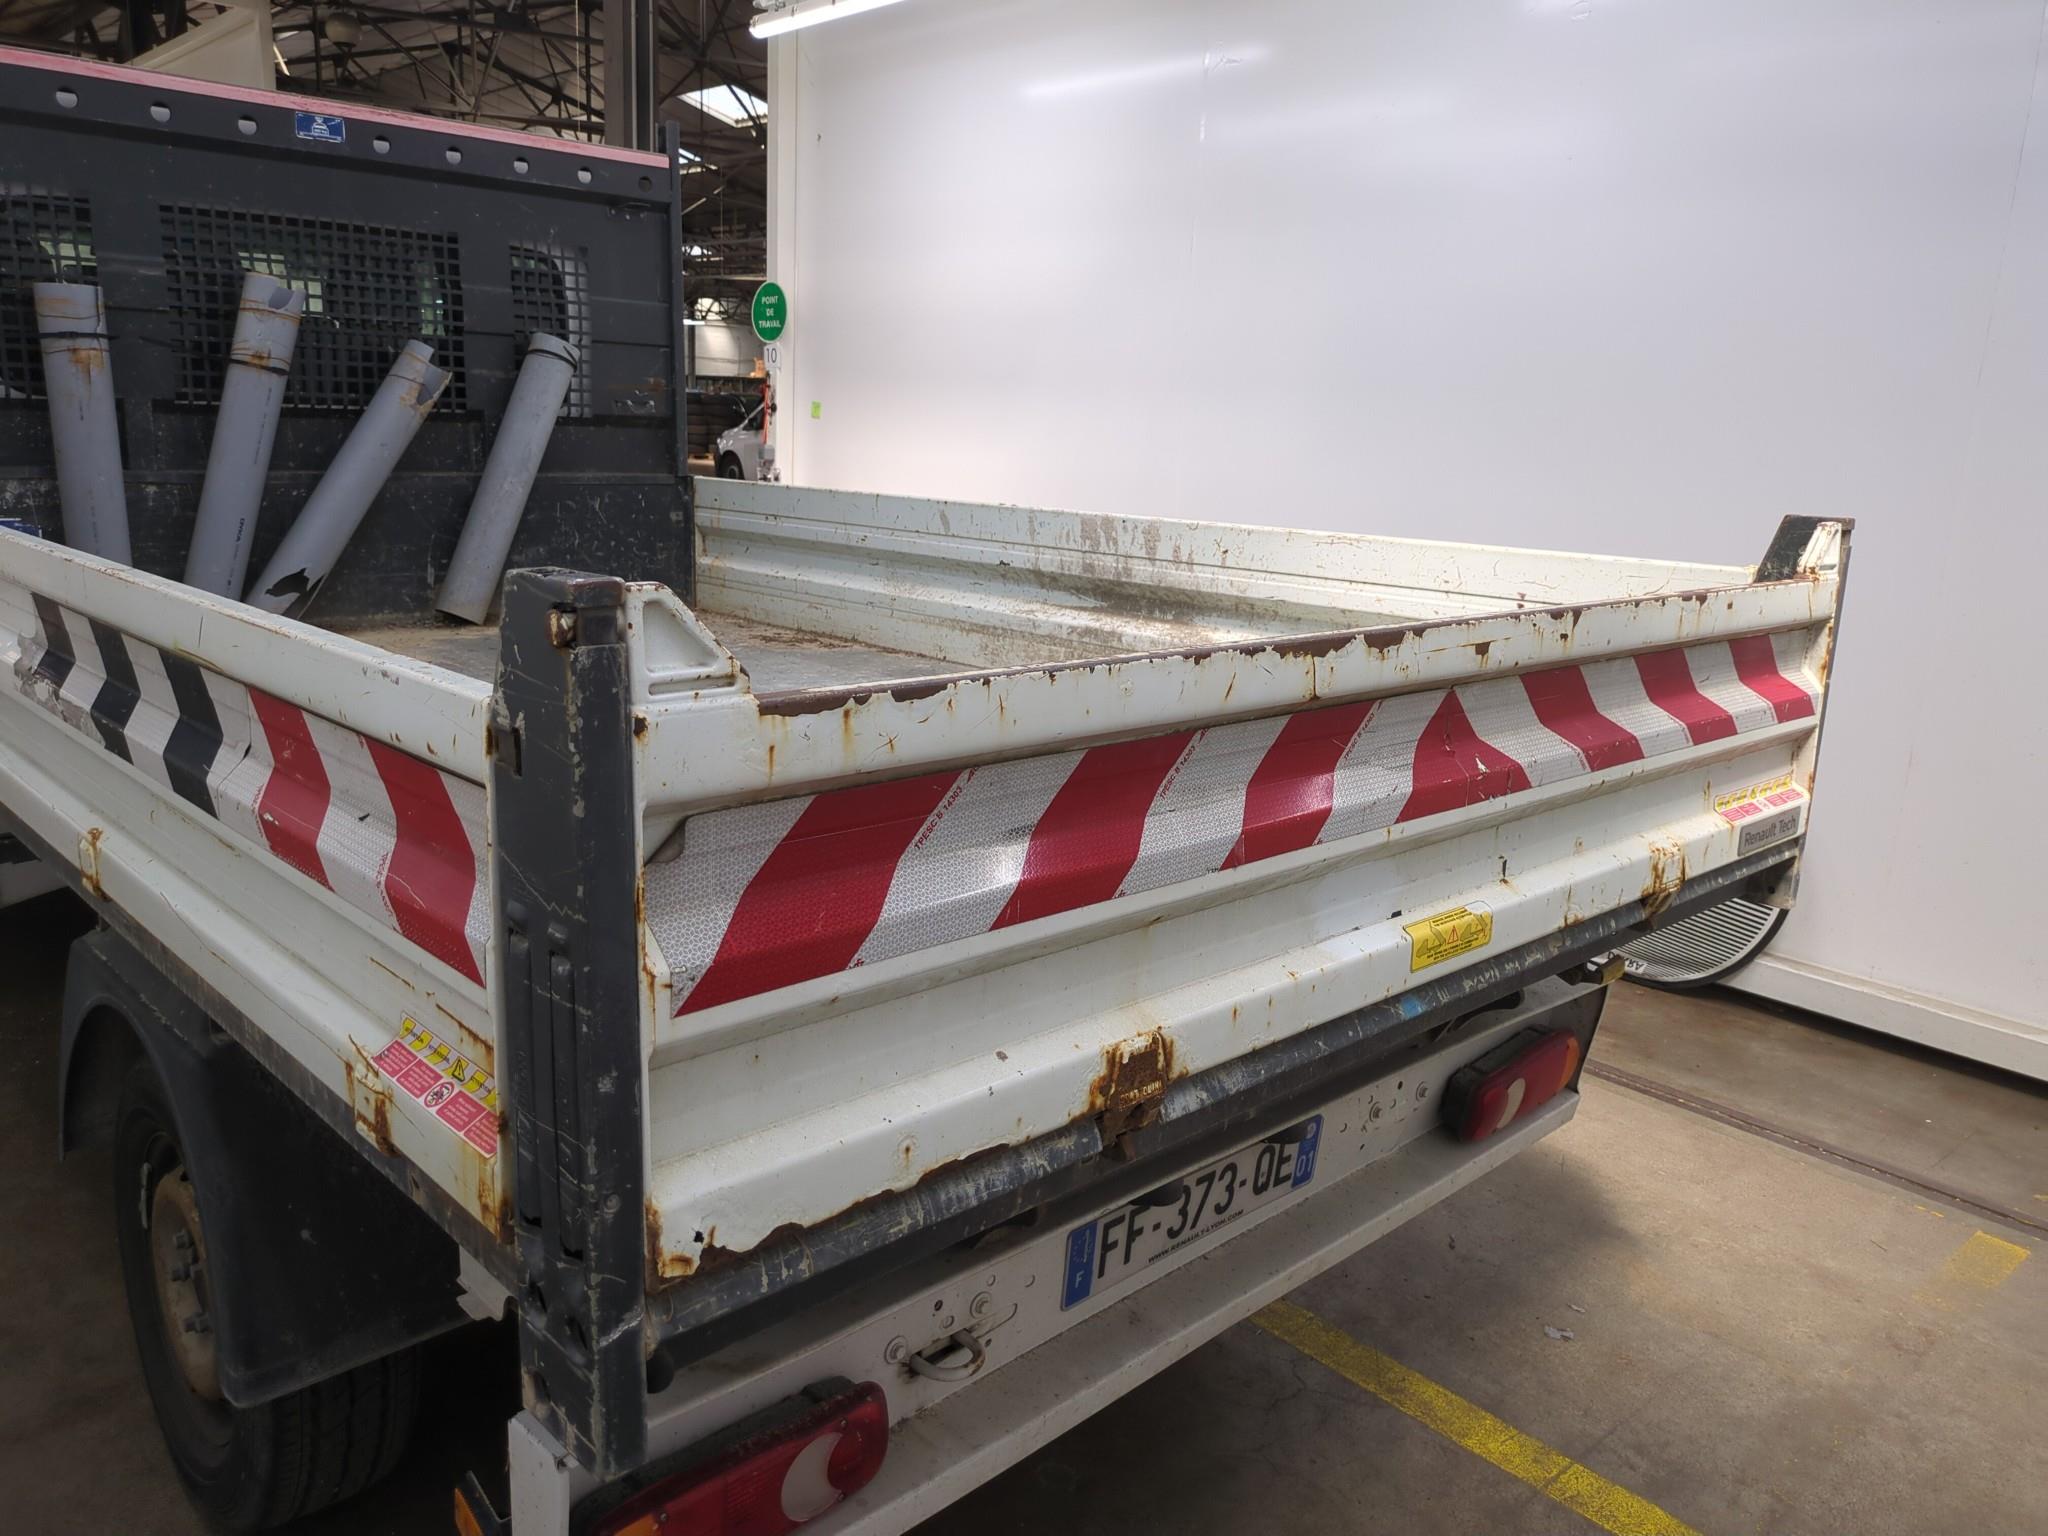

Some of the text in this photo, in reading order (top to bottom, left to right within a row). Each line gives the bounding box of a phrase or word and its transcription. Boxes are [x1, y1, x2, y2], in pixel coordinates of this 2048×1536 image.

[761, 295, 778, 305] POINT
[766, 308, 774, 316] DE
[758, 320, 781, 328] TRAVAIL
[766, 348, 777, 363] 10
[914, 818, 938, 851] TPESC
[943, 786, 963, 811] 14303
[1744, 815, 1796, 847] Renault Tech
[1075, 1272, 1083, 1289] F
[1296, 1151, 1314, 1177] 01
